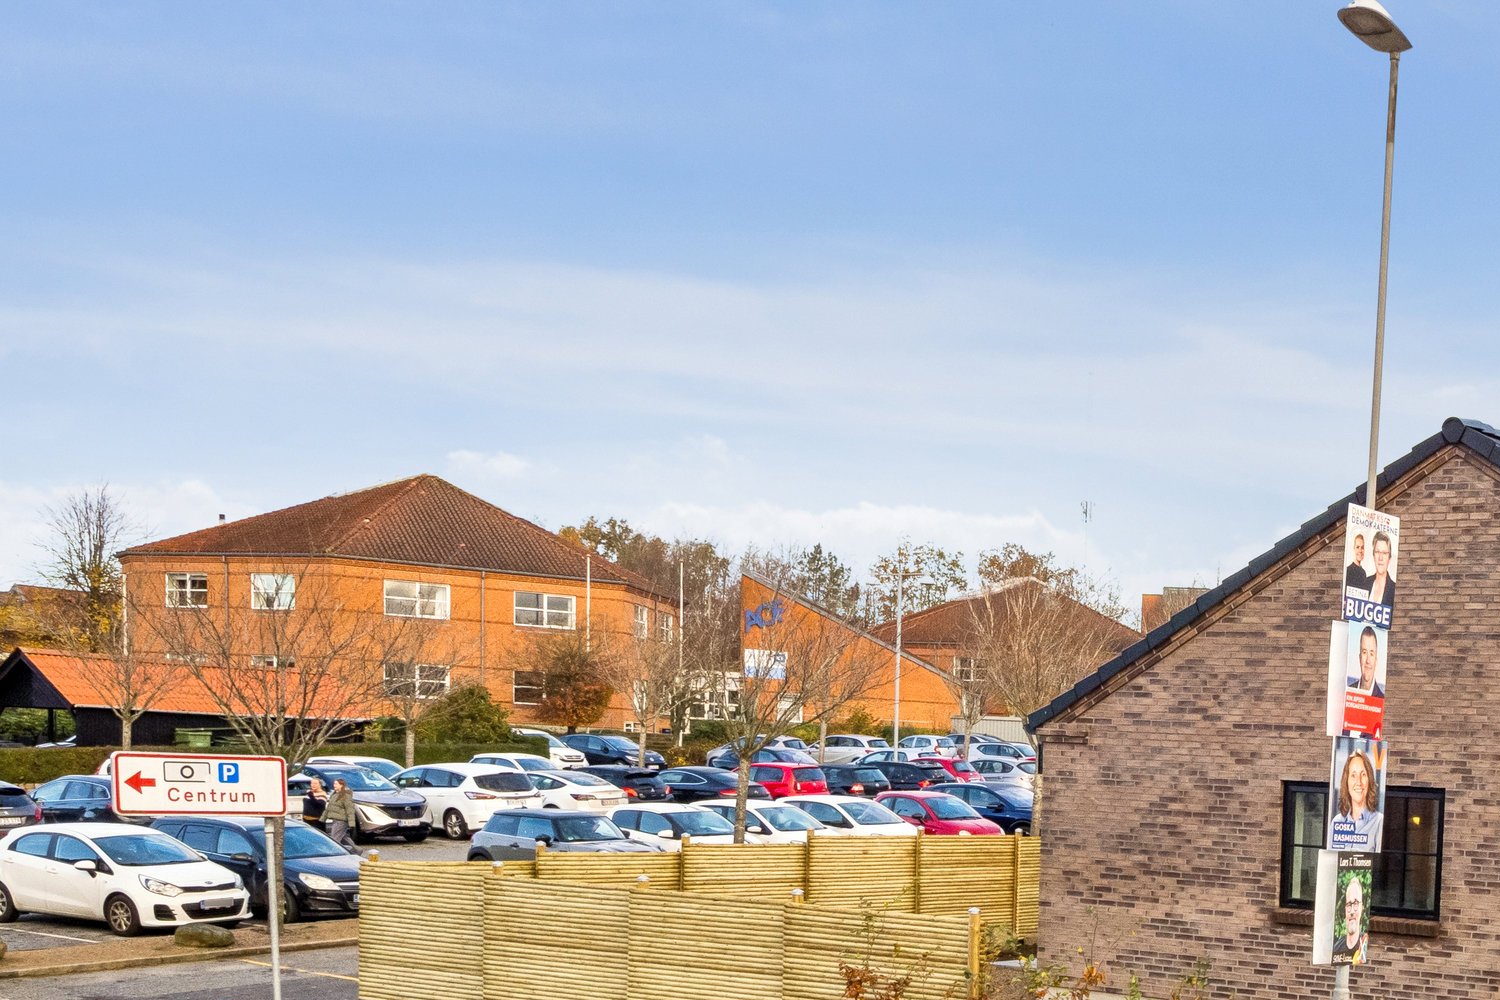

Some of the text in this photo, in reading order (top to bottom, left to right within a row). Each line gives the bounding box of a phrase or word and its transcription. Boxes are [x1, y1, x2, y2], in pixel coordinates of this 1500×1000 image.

[1352, 515, 1398, 536] DEMOKRATERNE
[1345, 598, 1391, 625] BUGGE
[1375, 728, 1380, 738] A
[1373, 744, 1387, 769] V
[223, 764, 236, 782] P
[167, 787, 256, 803] Centrum
[1334, 823, 1355, 831] GOSKA
[1333, 833, 1368, 843] RASMUSSEN
